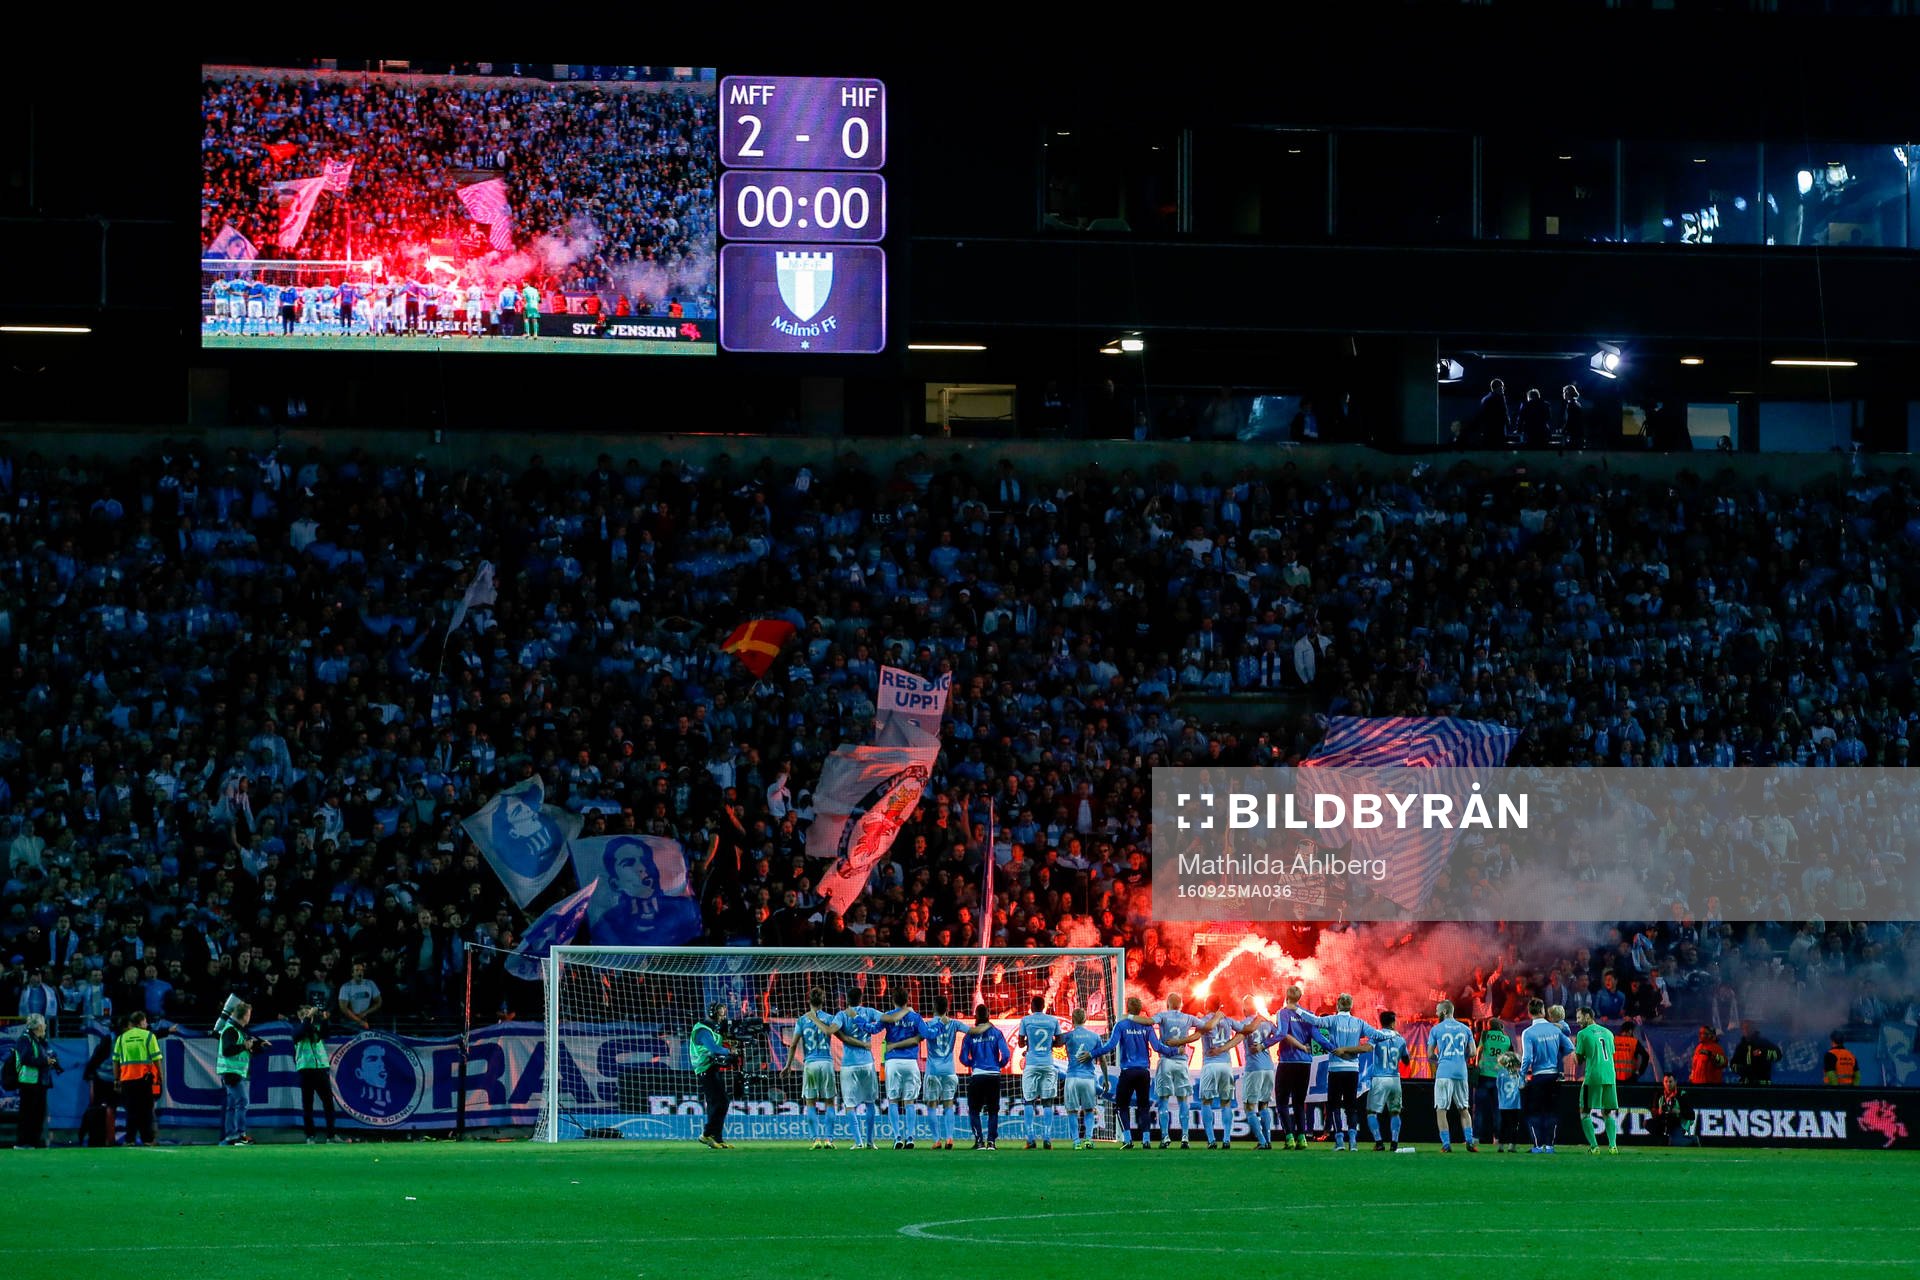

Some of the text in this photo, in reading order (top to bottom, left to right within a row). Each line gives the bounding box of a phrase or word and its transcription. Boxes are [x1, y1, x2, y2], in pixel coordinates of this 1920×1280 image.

[730, 85, 776, 105] MFF
[841, 87, 878, 107] HIF
[738, 115, 764, 157] 2
[842, 117, 869, 159] 0
[737, 185, 870, 229] 00:00
[771, 315, 837, 336] Malmö FF
[882, 670, 917, 690] RES
[895, 691, 938, 709] UPP!
[1034, 1028, 1049, 1051] 2
[1441, 1032, 1466, 1056] 23
[1599, 1038, 1608, 1062] 1
[1381, 1045, 1400, 1069] 13
[690, 1118, 745, 1135] Hva
[752, 1118, 809, 1138] priset
[1591, 1107, 1848, 1140] SYDENSKAN
